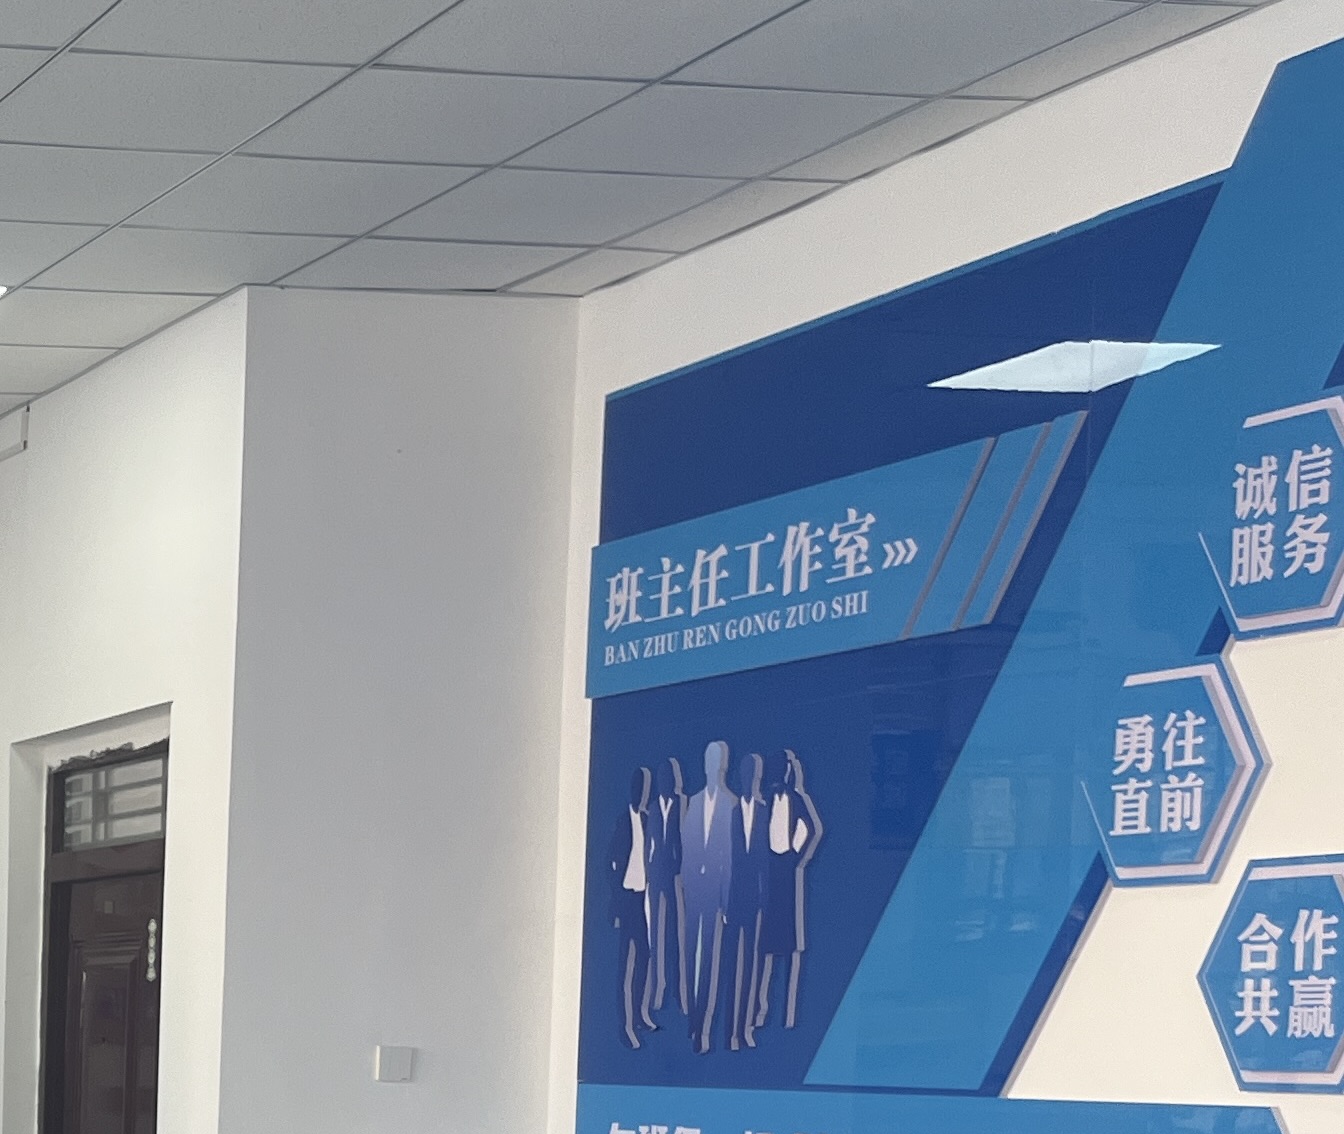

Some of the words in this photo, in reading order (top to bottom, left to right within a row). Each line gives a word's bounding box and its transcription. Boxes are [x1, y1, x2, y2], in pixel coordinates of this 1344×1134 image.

[1232, 443, 1334, 521] 诚信
[603, 507, 877, 634] 班主任工作室
[1229, 512, 1331, 588] 服务
[603, 639, 640, 667] BAN
[642, 631, 680, 660] ZHU
[682, 623, 721, 652] REN
[725, 609, 782, 641] GONG
[785, 600, 827, 630] ZUO
[830, 590, 870, 619] SHI
[1112, 709, 1207, 776] 勇往
[1108, 772, 1205, 837] 直前
[1236, 908, 1340, 973] 合作
[1234, 975, 1336, 1039] 共赢
